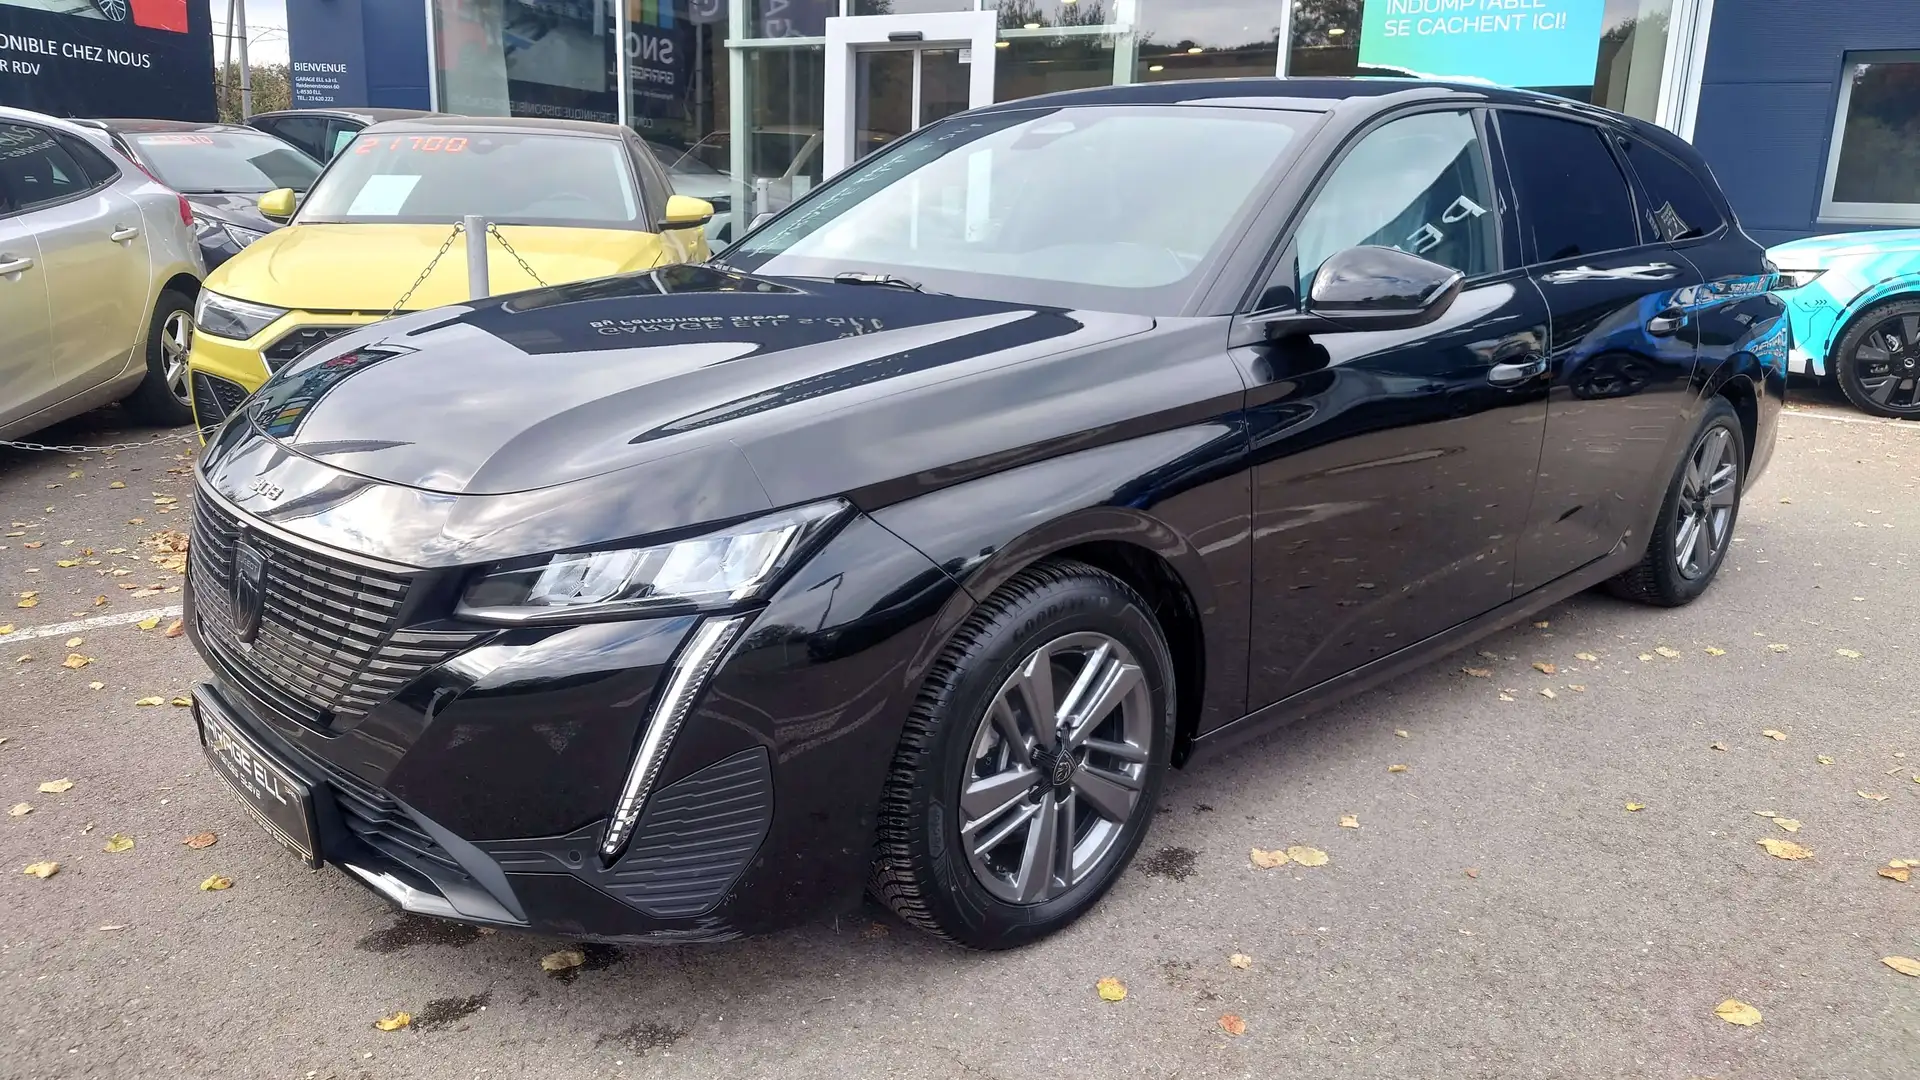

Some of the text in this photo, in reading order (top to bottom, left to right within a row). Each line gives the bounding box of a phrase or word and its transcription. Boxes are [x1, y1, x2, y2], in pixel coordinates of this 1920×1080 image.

[1384, 12, 1567, 37] SE CACHENT ICI!
[12, 60, 41, 76] RDV
[62, 43, 103, 62] CHEZ
[107, 49, 151, 69] NOUS
[294, 62, 347, 73] BIENVENUE
[355, 135, 468, 155] 21700
[249, 476, 284, 501] 308
[253, 760, 287, 806] ELL
